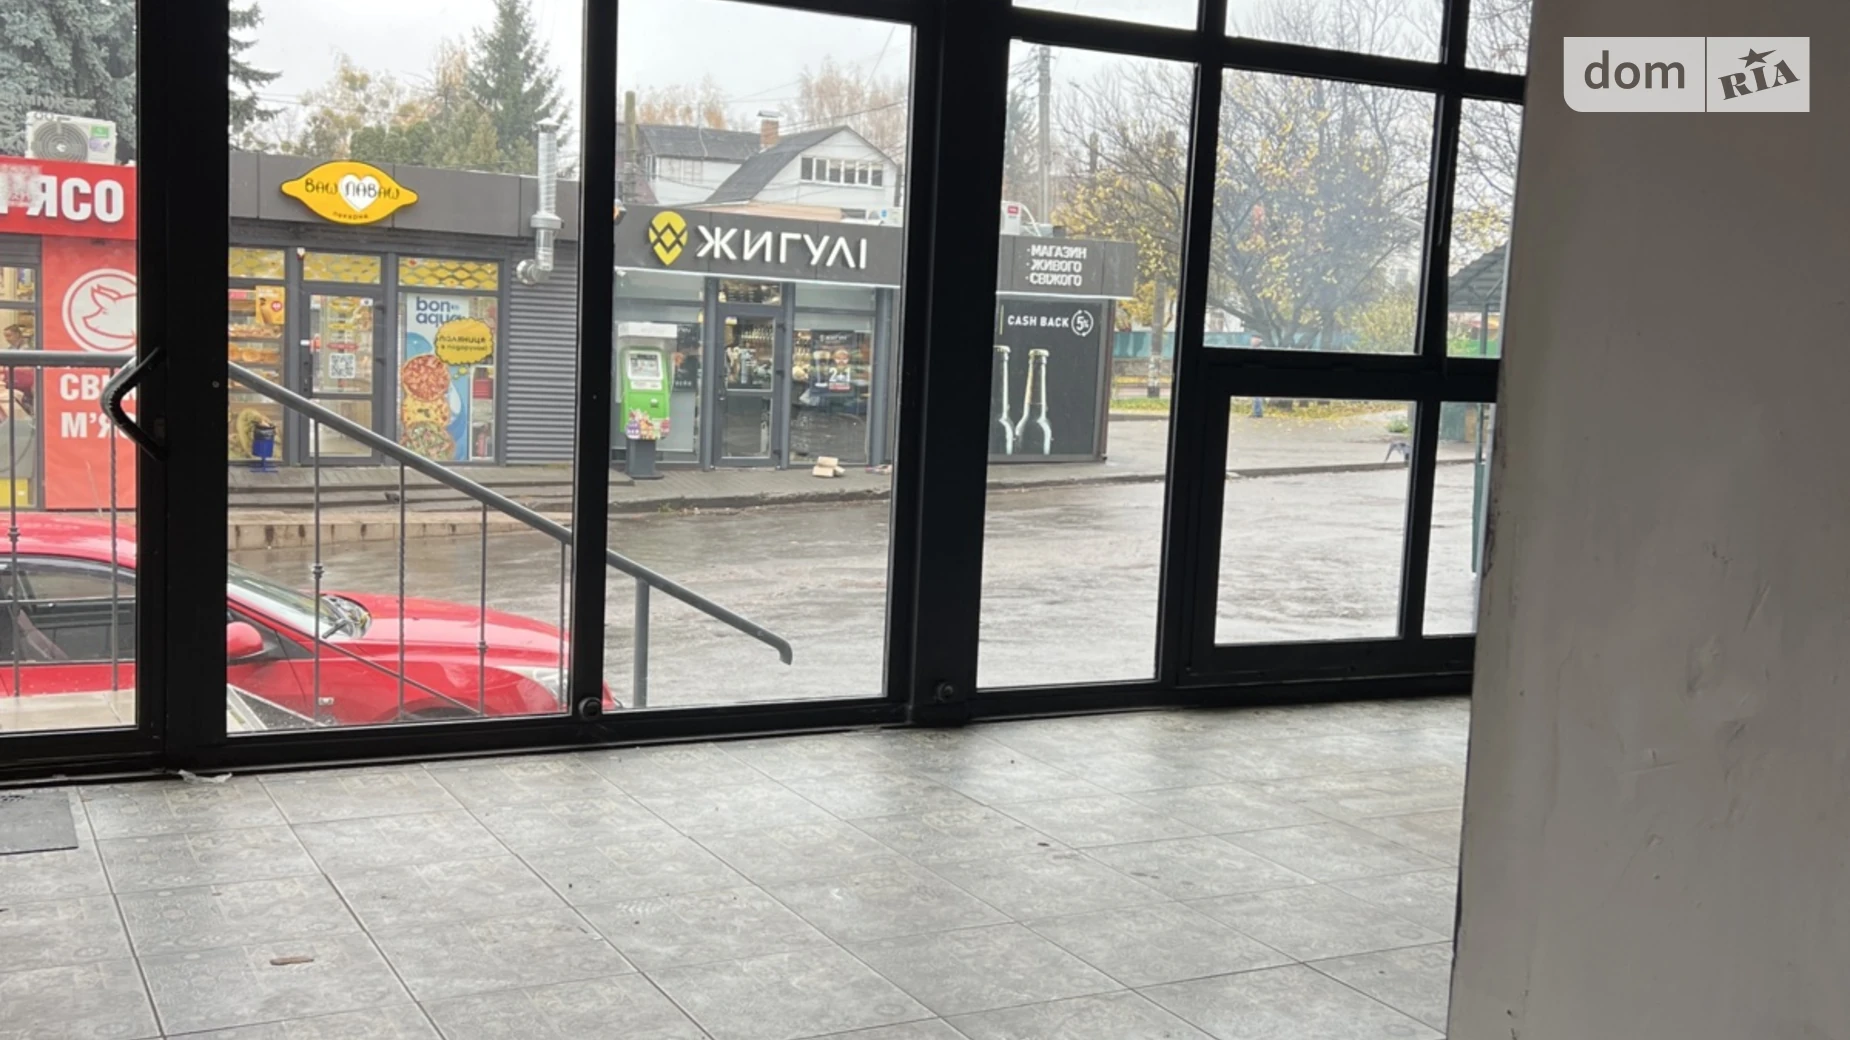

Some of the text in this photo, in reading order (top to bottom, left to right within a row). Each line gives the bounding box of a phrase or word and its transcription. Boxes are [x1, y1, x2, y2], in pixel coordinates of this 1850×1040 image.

[696, 225, 867, 269] ЖИГУЛІ
[1031, 244, 1087, 259] МАГАЗИН
[1031, 259, 1082, 273] ЖИВОГО
[1029, 272, 1082, 287] СВІЖОГО
[416, 296, 450, 312] bon
[1007, 315, 1037, 326] CASH
[1040, 316, 1069, 328] BACK
